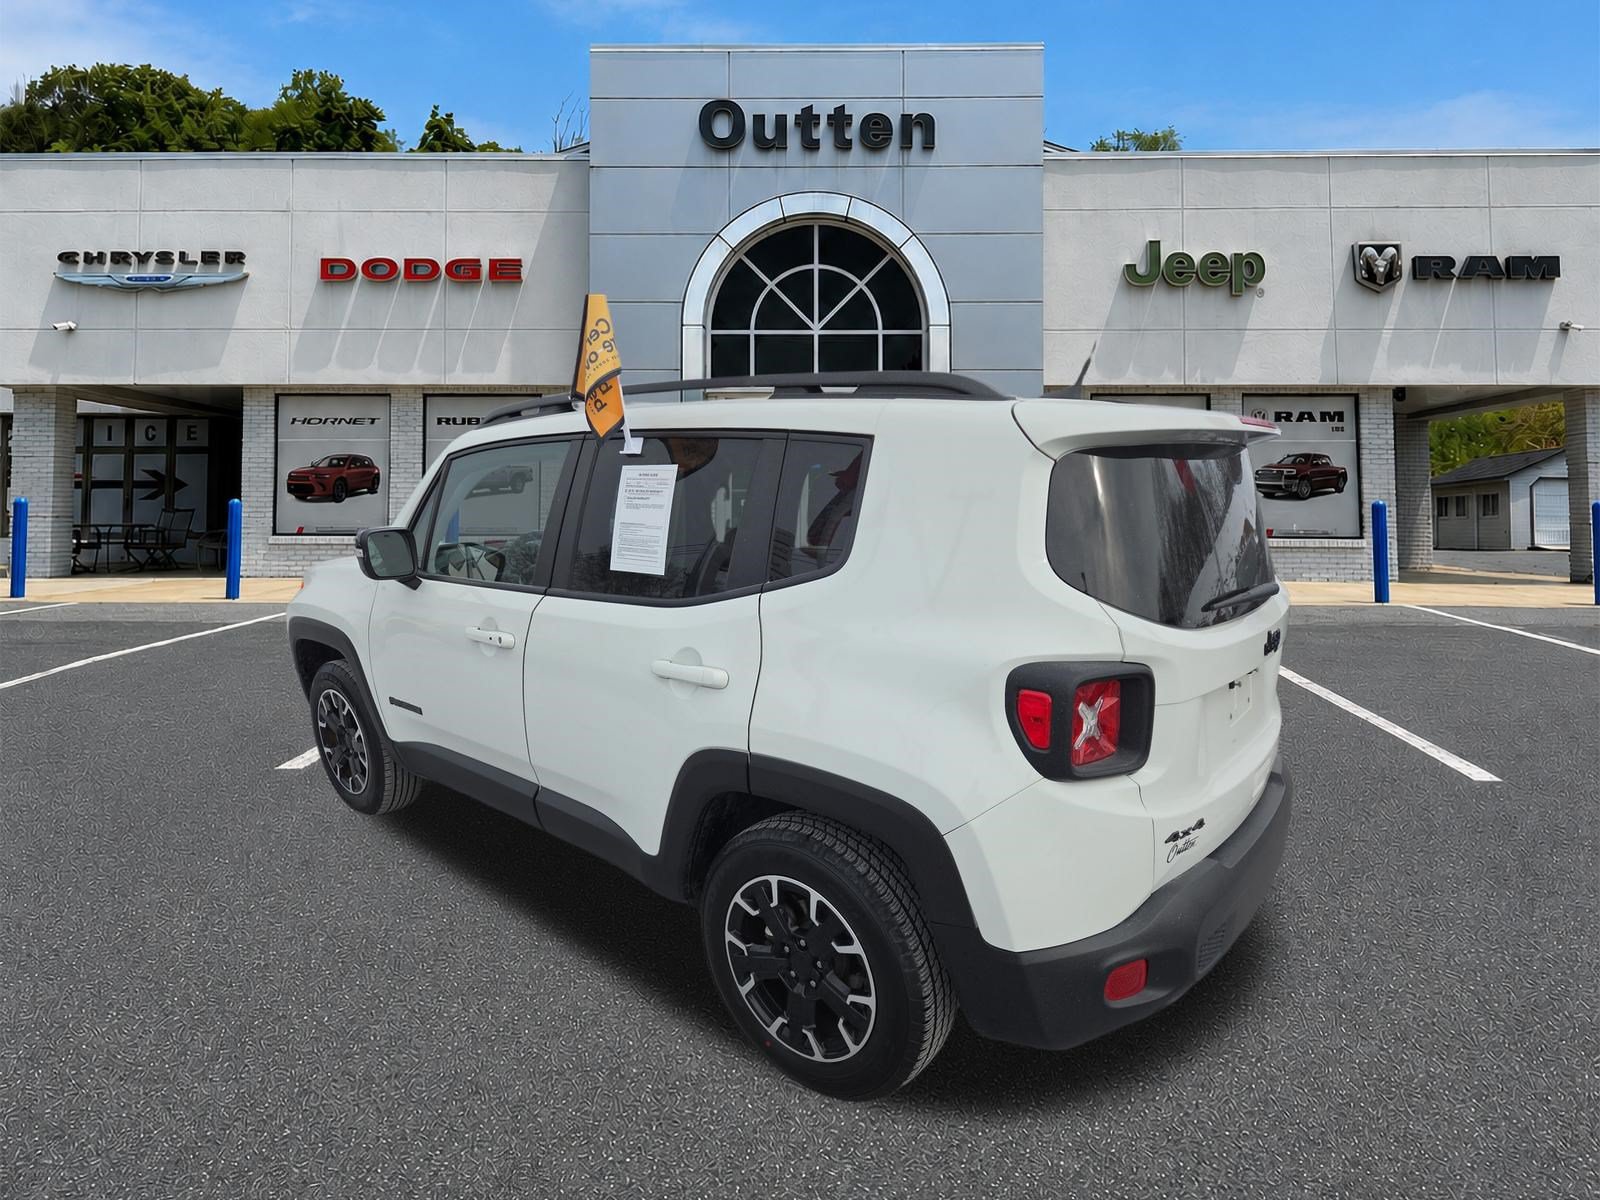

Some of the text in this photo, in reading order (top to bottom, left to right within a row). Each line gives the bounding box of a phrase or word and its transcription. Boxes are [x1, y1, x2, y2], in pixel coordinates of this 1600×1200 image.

[699, 98, 936, 151] Outten
[57, 251, 246, 265] CHRYSLER
[1411, 255, 1561, 280] RAM
[319, 257, 524, 283] DODGE
[1123, 240, 1266, 297] Jeep
[290, 417, 381, 426] HORNET
[436, 417, 484, 426] RUB
[1274, 411, 1345, 423] RAM
